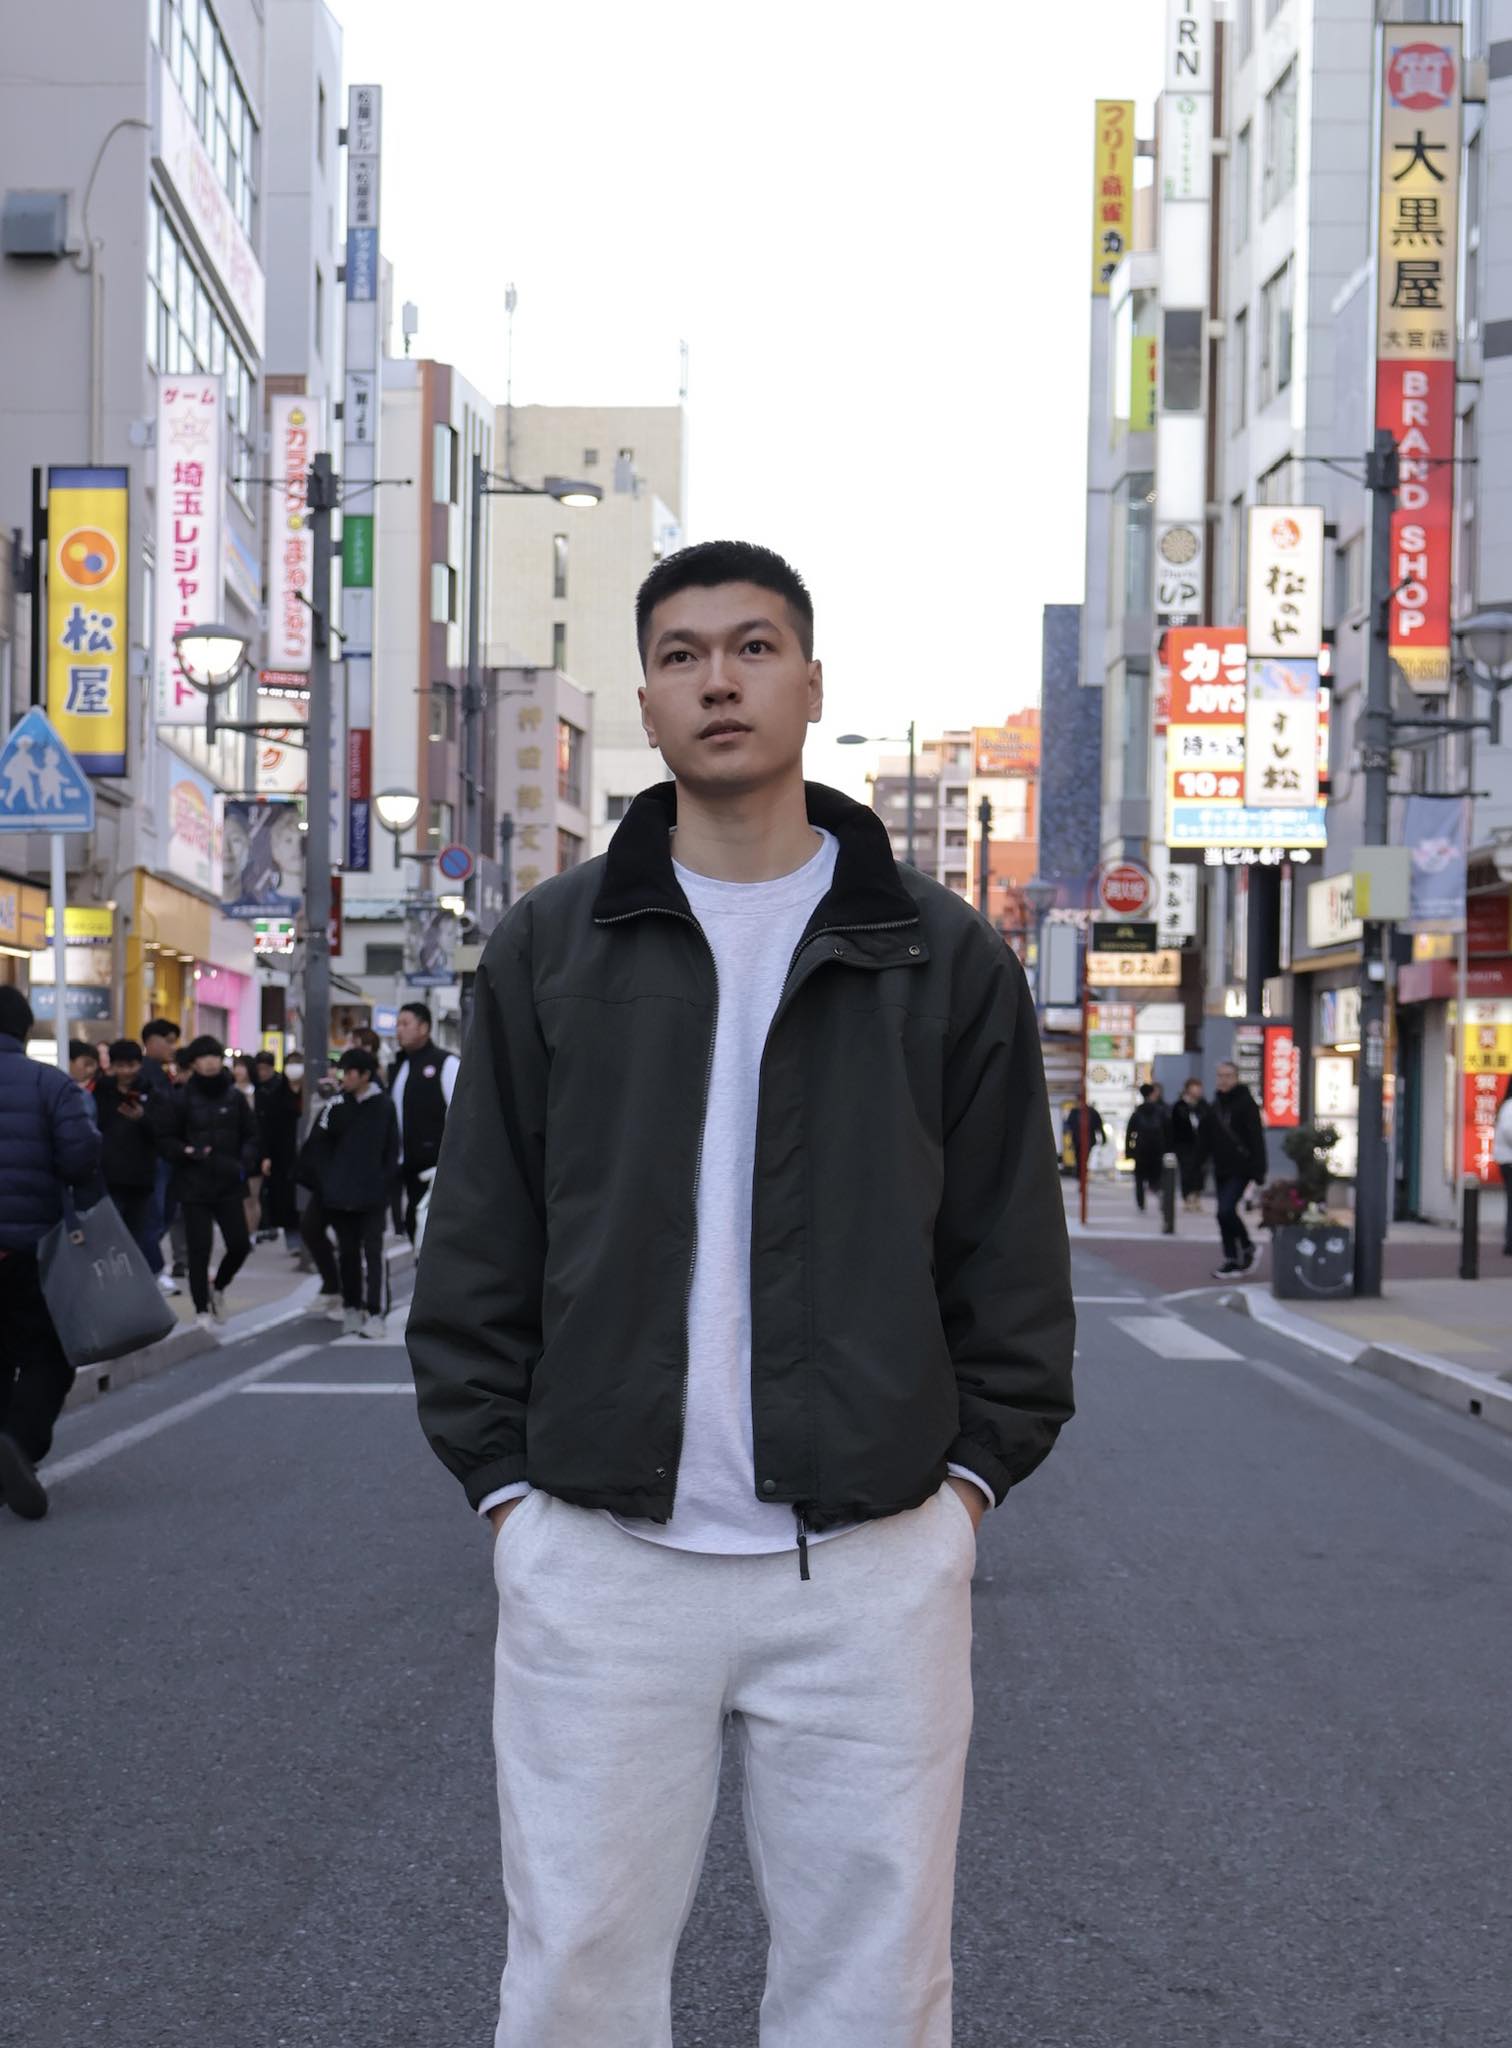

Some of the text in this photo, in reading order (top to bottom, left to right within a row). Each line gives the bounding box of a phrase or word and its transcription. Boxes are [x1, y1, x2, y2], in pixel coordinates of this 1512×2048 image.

[1395, 52, 1449, 98] 質
[1102, 104, 1125, 222] フリー麻雀
[1391, 130, 1447, 310] 大黒屋
[1383, 330, 1449, 350] 大宮店
[163, 387, 216, 405] ゲーム
[1398, 370, 1431, 511] BRAND
[1264, 564, 1307, 644] 松のや
[1396, 525, 1428, 638] SHOP
[61, 605, 116, 716] 松屋
